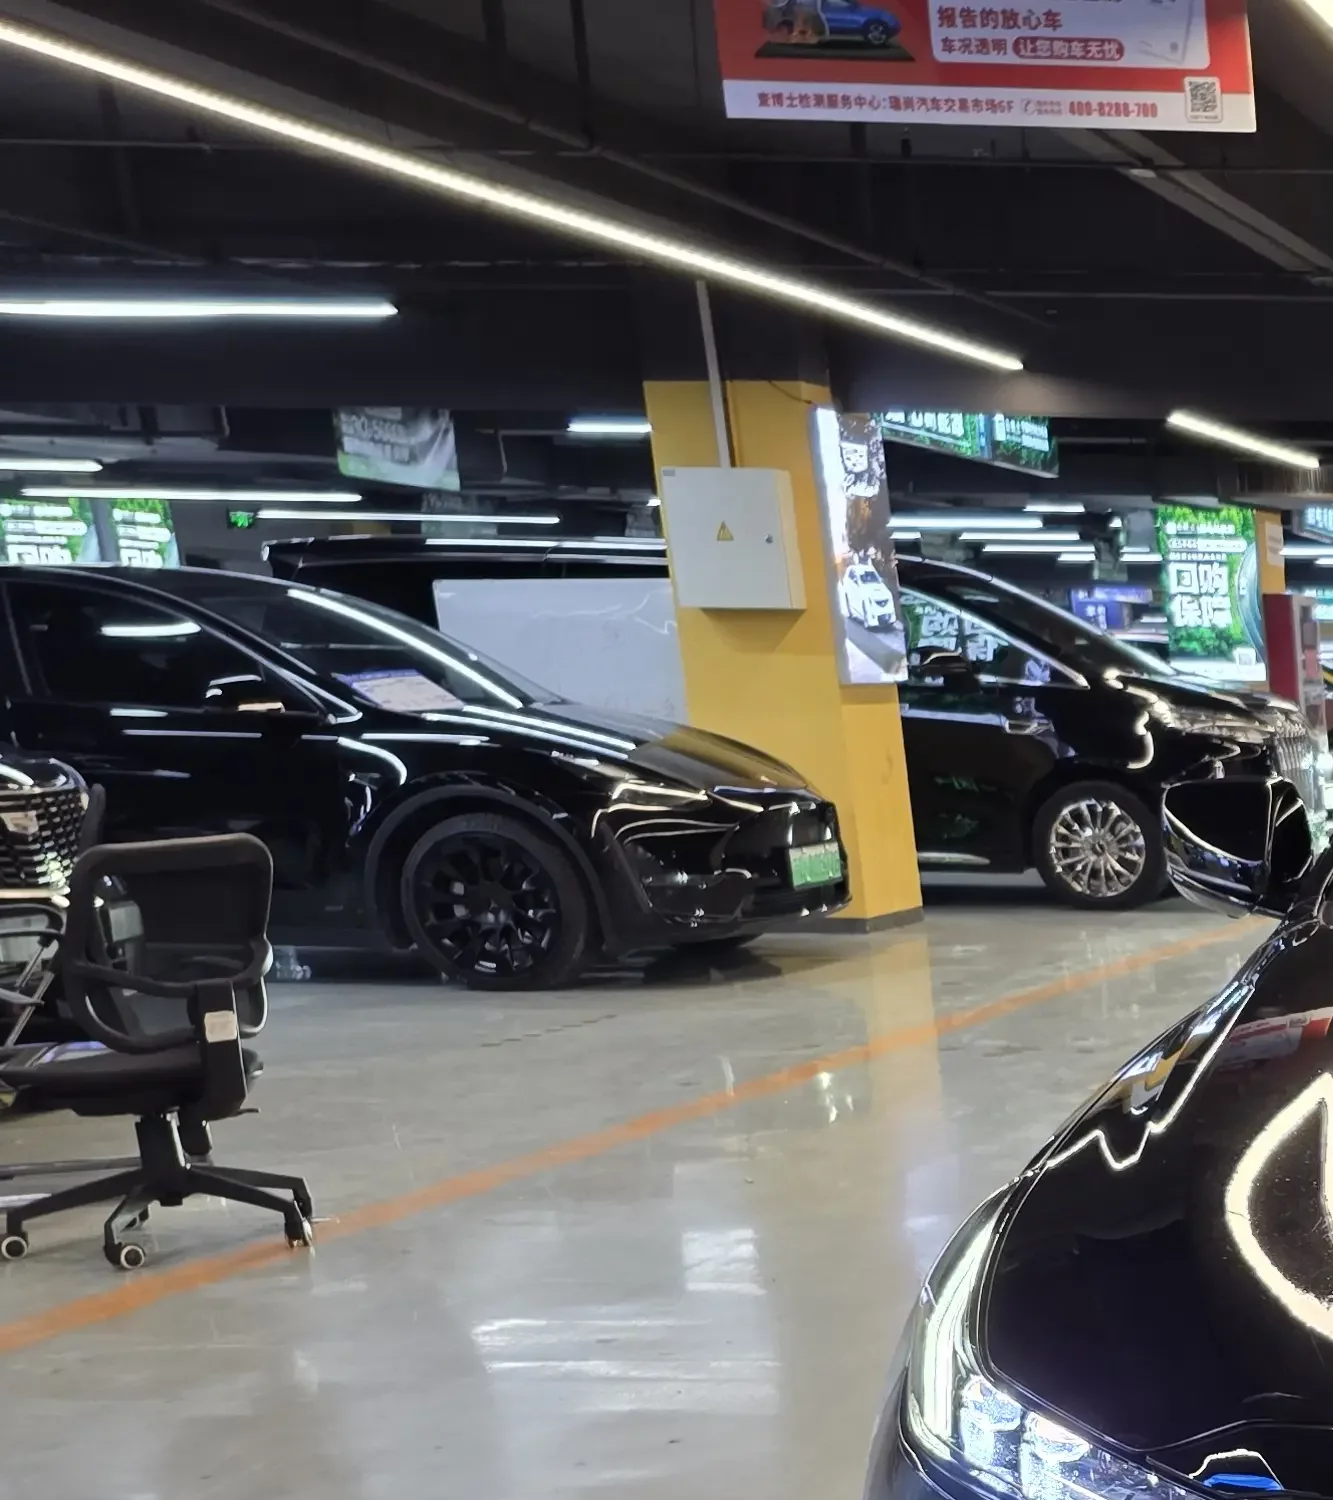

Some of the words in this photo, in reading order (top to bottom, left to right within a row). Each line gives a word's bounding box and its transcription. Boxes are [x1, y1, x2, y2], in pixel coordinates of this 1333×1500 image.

[937, 6, 1063, 31] 报告的放心车
[941, 37, 1008, 57] 车况透明
[1018, 39, 1121, 60] 让您购车无忧
[1169, 561, 1228, 595] 回购
[1170, 594, 1232, 628] 保障
